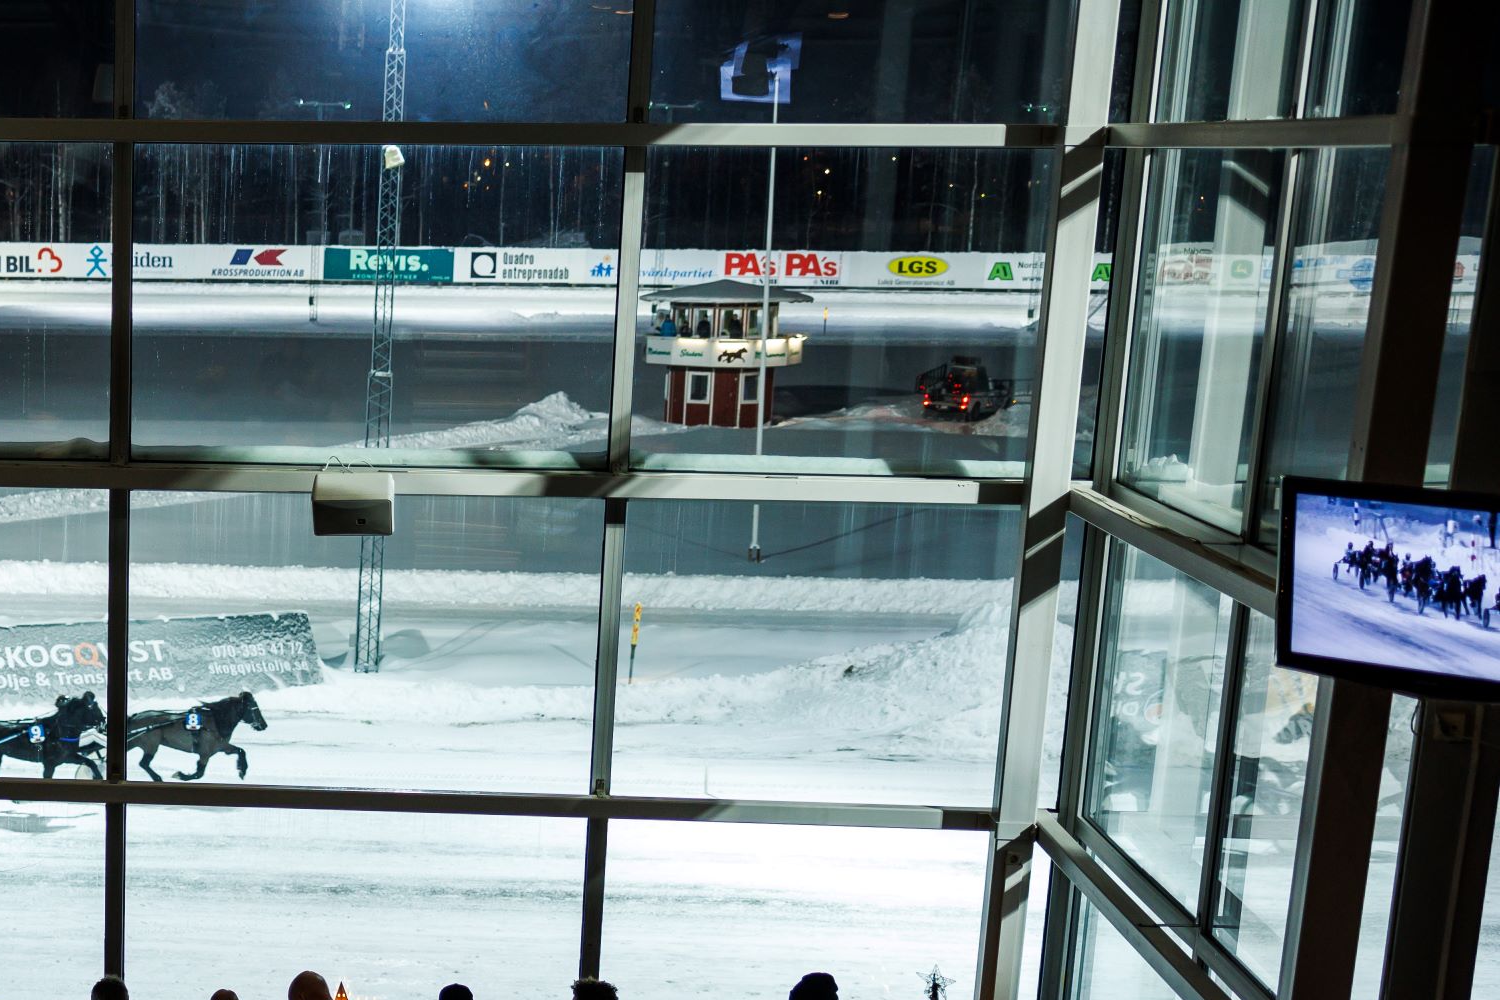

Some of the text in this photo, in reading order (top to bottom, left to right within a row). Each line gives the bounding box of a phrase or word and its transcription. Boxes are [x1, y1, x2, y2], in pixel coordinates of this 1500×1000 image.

[6, 256, 35, 273] BIL
[503, 252, 535, 265] Quadro
[211, 268, 291, 277] KROSSPRODUKTION
[502, 267, 569, 281] entreprenadab
[898, 261, 938, 274] LGS
[36, 671, 50, 687] &
[54, 668, 143, 686] Transrt
[148, 667, 173, 681] AB
[187, 713, 198, 726] 8
[31, 726, 41, 740] 9
